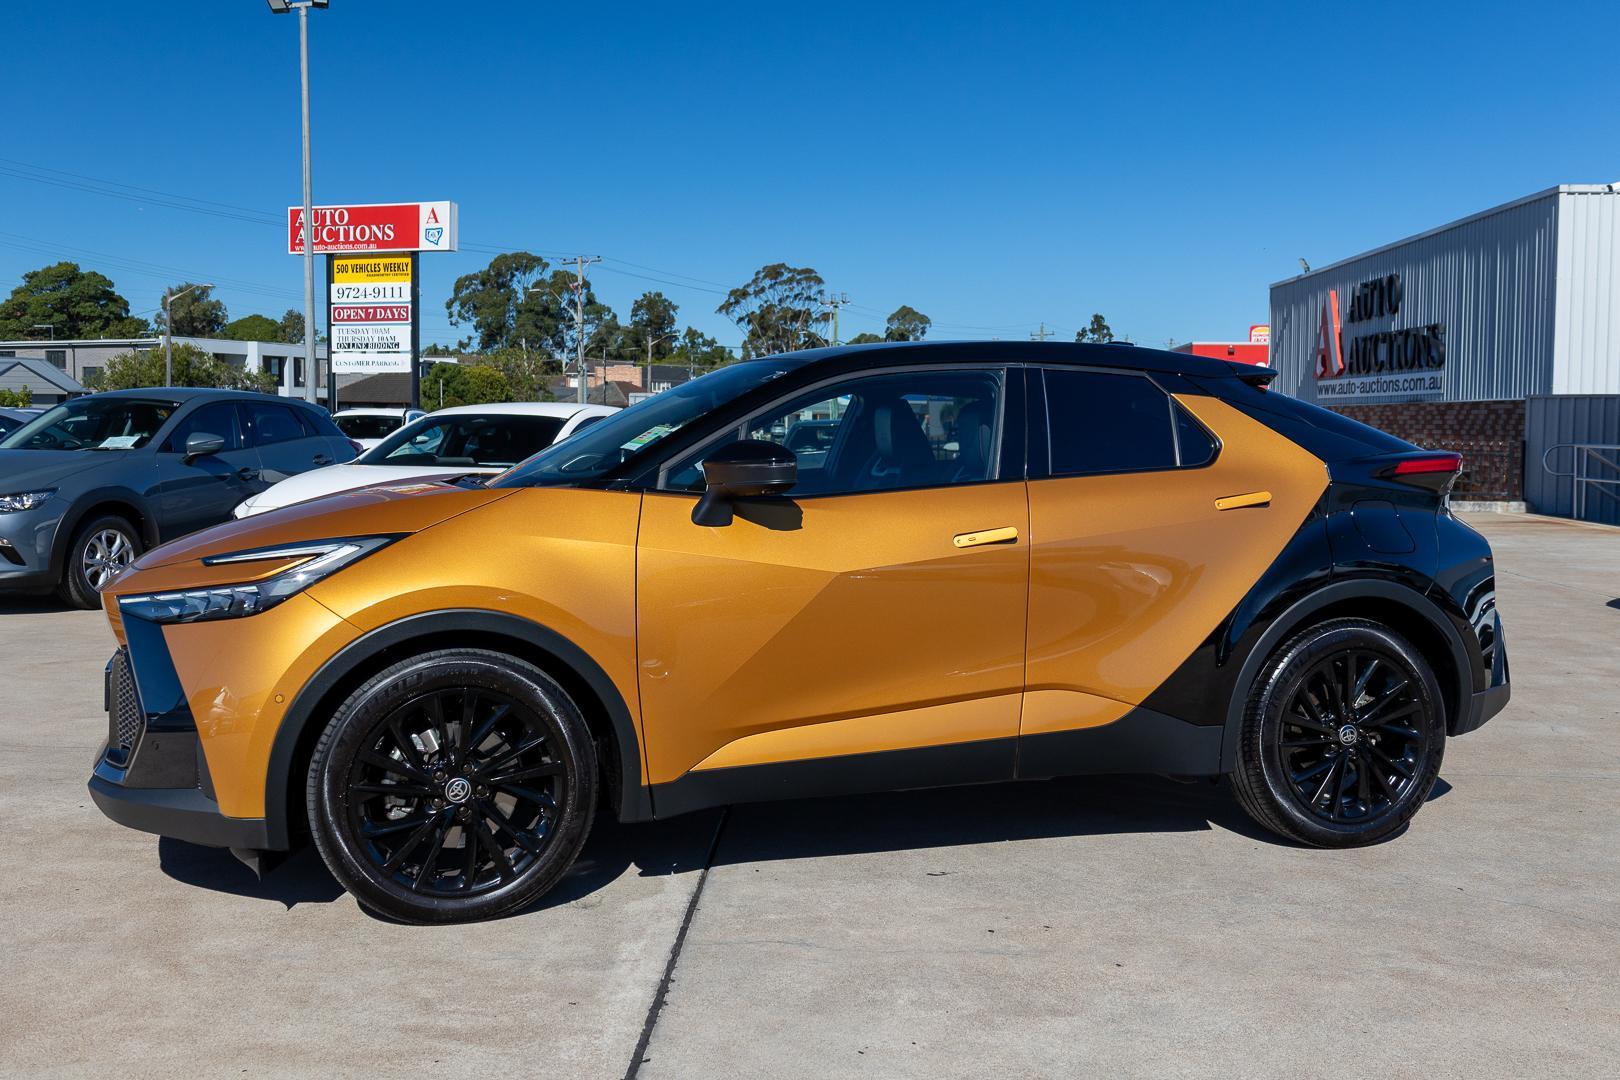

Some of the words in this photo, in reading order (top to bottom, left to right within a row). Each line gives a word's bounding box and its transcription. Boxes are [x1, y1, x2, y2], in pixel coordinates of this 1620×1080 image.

[295, 208, 349, 226] AUTO
[426, 206, 440, 224] A
[295, 224, 395, 243] AUCTIONS
[294, 242, 378, 252] wwauto-auctions.com.au
[336, 263, 349, 274] 500
[351, 262, 381, 273] VEHICLES
[382, 262, 409, 273] WEEKLY
[336, 286, 403, 300] 9724-9111
[1347, 272, 1402, 323] AUTO
[334, 308, 366, 320] OPEN
[367, 309, 374, 320] 7
[376, 307, 407, 319] DAYS
[336, 327, 370, 335] TUESDAY
[371, 327, 390, 335] 10AM
[1347, 323, 1446, 375] AUCTIONS
[1317, 375, 1443, 396] www.auto-auctions.com.au
